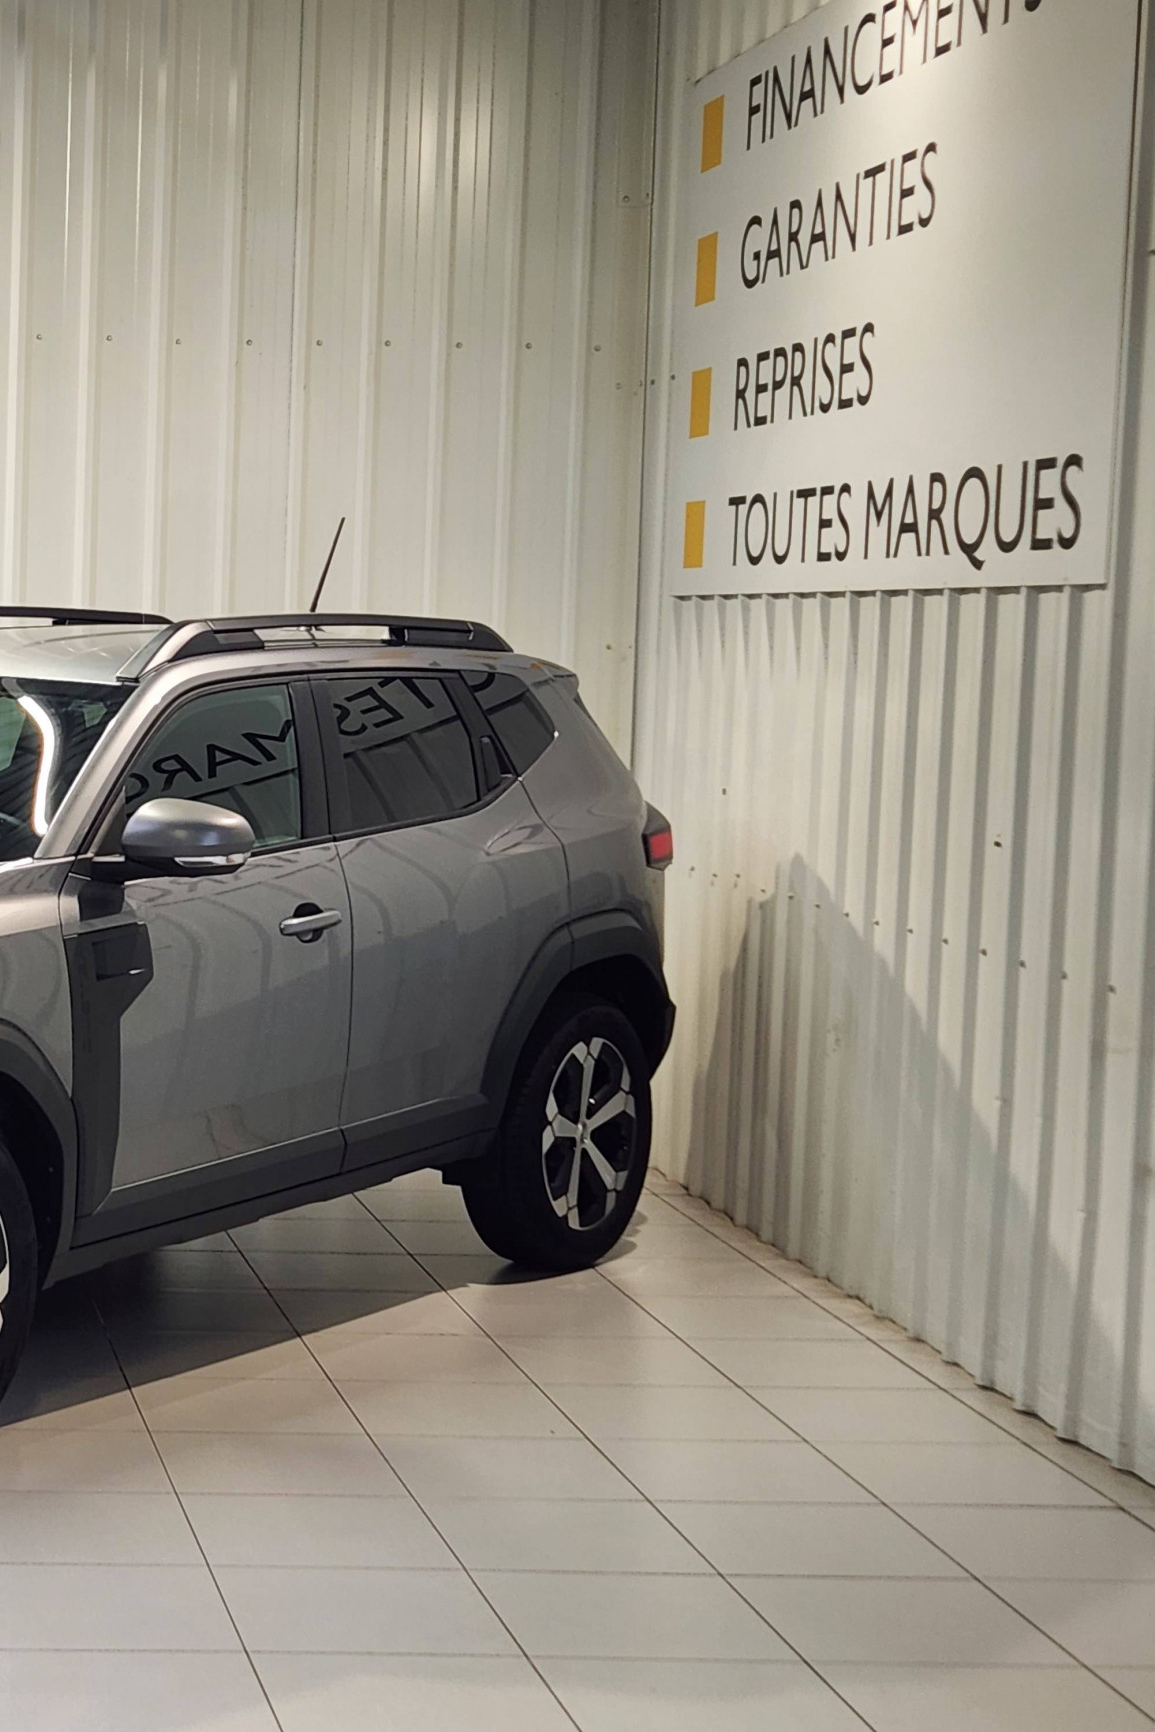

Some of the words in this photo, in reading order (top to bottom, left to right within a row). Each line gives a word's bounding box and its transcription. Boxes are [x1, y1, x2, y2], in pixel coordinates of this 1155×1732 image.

[746, 0, 1042, 151] FINANCEMEN
[740, 142, 938, 289] GARANTIES
[733, 322, 875, 431] REPRISES
[728, 483, 852, 567] TOUTES
[863, 453, 1084, 571] MARQUES
